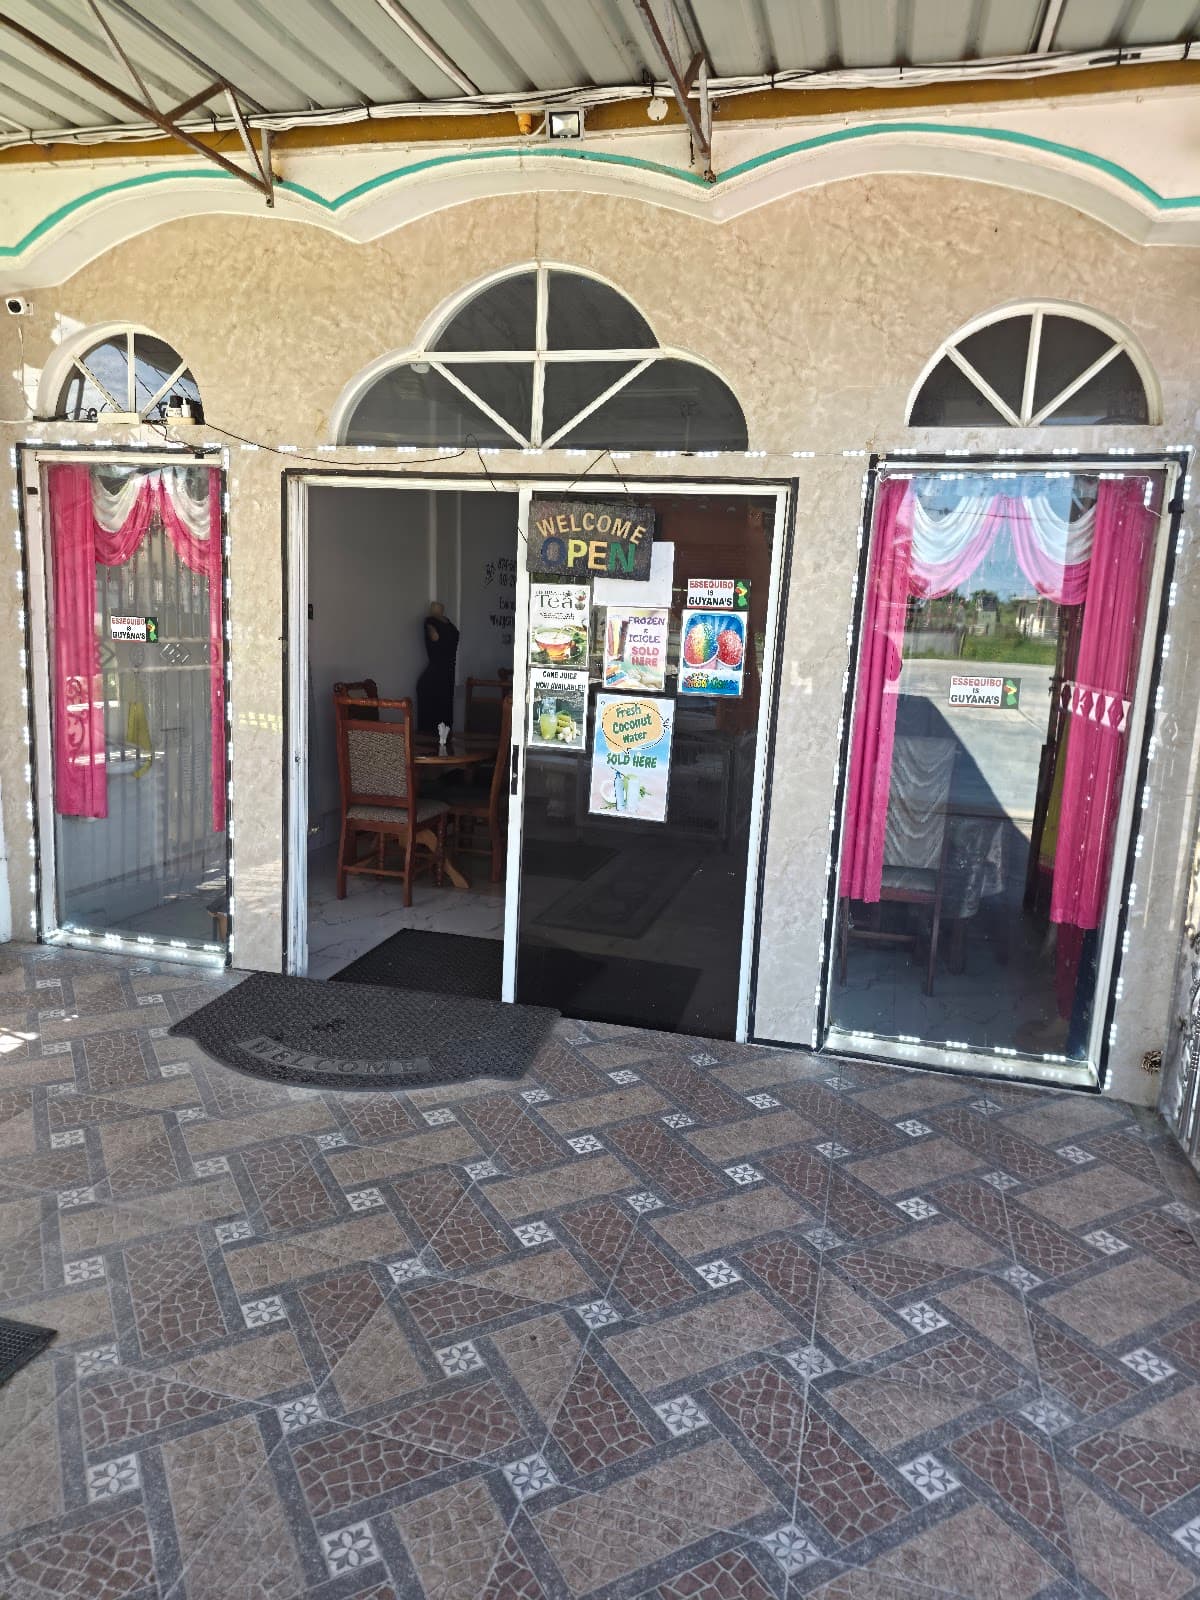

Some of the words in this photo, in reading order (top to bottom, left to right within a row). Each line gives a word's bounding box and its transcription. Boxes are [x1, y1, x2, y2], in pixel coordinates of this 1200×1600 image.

[536, 512, 647, 545] WELCOME
[541, 536, 636, 574] OPEN
[689, 580, 734, 590] ESSEQUIBO
[535, 594, 573, 609] Tea
[688, 596, 733, 607] GUYANA'S
[111, 617, 145, 625] ESSEQUIBO
[628, 616, 666, 626] FROZEN
[112, 631, 145, 639] GUYANA'S
[628, 634, 661, 644] ICICLE
[631, 646, 660, 657] SOLD
[631, 656, 658, 667] HERE
[542, 670, 559, 679] CANE
[535, 681, 550, 689] NOW
[952, 678, 1001, 687] ESSEQUIBO
[951, 695, 1000, 704] GUYANA'S
[615, 704, 642, 719] Fresh
[612, 713, 653, 735] Coconut
[622, 731, 648, 744] Water
[606, 752, 632, 766] SOLD
[632, 754, 658, 769] HERE
